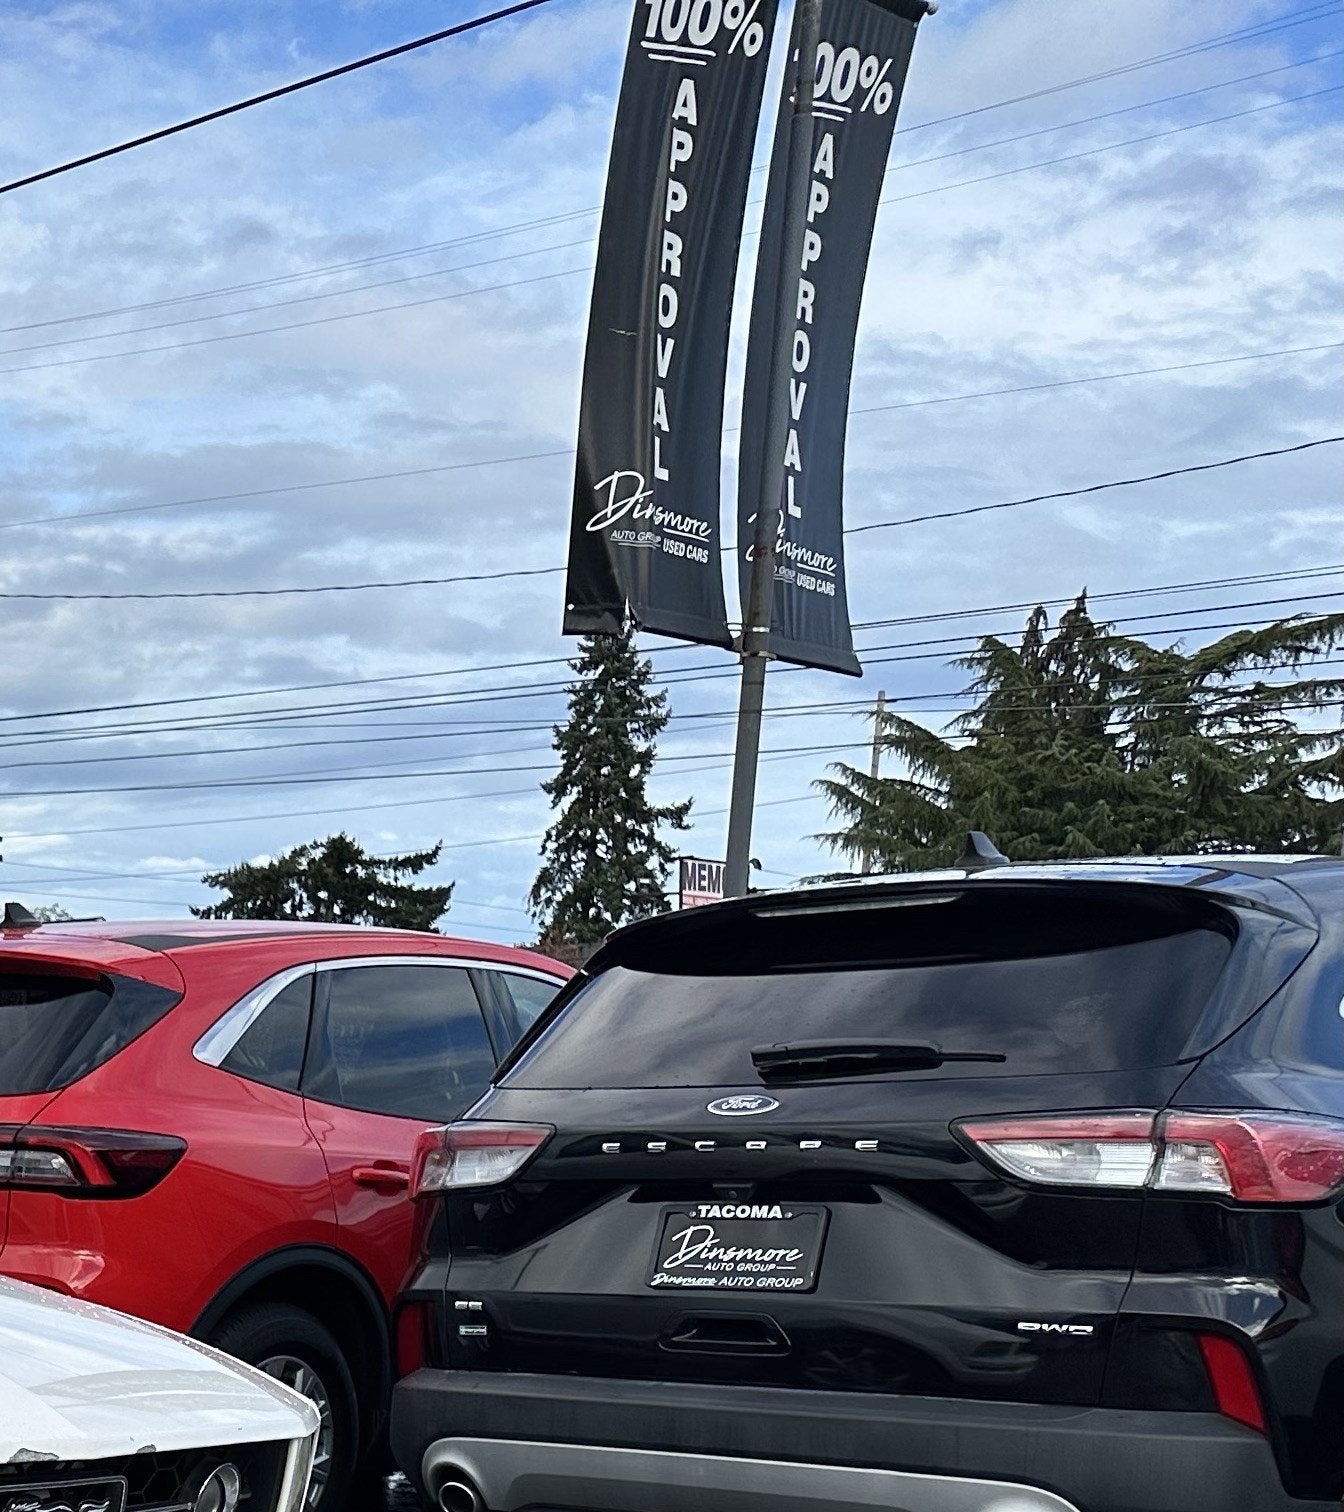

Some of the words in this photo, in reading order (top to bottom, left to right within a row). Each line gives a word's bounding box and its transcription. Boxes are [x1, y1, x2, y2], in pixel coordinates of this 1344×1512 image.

[644, 0, 764, 57] 100%
[792, 41, 894, 115] 00%
[653, 78, 698, 481] APPROVAL
[784, 133, 834, 519] APPROVAL
[585, 470, 712, 537] Dinsmore
[663, 538, 686, 557] USED
[686, 544, 709, 563] CARS
[745, 509, 837, 572] insmore
[797, 573, 816, 590] USED
[682, 861, 726, 893] MEM
[602, 1139, 879, 1153] ESCAPE
[697, 1204, 783, 1219] TACOMA
[662, 1224, 804, 1269] Dinsmore
[704, 1262, 734, 1272] AUTO
[736, 1262, 777, 1272] GROUP
[715, 1276, 755, 1287] AUTO
[756, 1277, 804, 1288] GROUP
